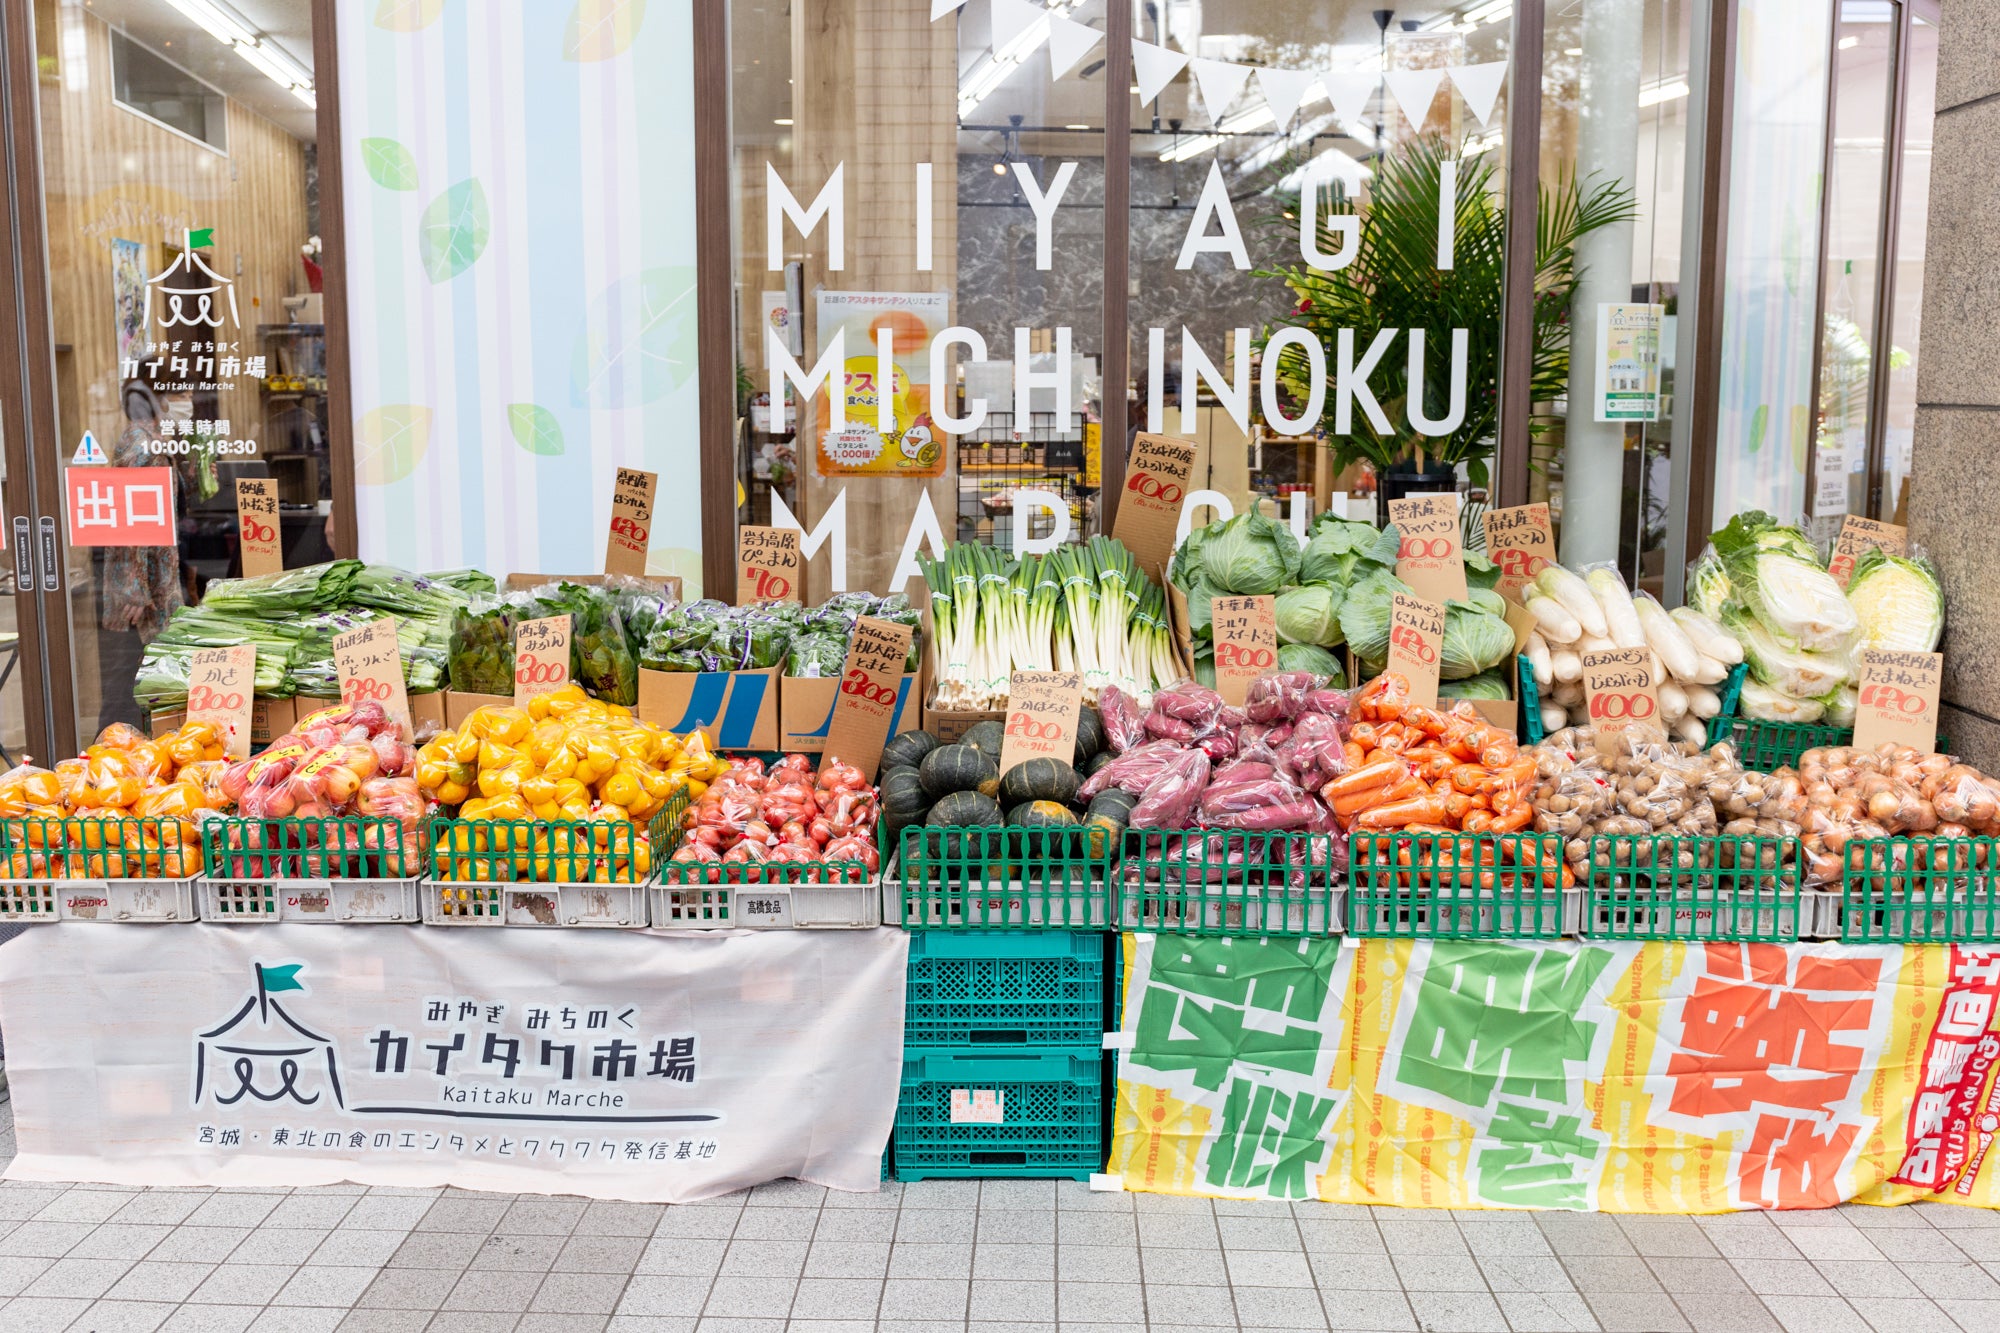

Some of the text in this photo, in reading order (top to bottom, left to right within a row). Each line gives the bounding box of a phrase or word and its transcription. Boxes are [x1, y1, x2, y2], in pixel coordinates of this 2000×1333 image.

[766, 158, 1456, 271] MIYAGI
[146, 340, 240, 353] みやぎ みちのく
[121, 355, 267, 379] カイタク市場
[153, 381, 235, 391] Kaitaku Marche
[768, 324, 1470, 436] MICHINOKU
[159, 419, 230, 436] 営業時間
[76, 480, 166, 528] 出口
[240, 497, 277, 514] 小松菜
[242, 514, 276, 543] 50
[1487, 510, 1533, 532] 青森産
[742, 530, 795, 550] 岩手高原
[1491, 527, 1546, 549] だいこん
[746, 567, 790, 599] 70
[1214, 597, 1257, 612] 千葉産
[1217, 617, 1248, 629] シルク
[335, 627, 374, 651] 山形産
[525, 630, 565, 652] みかん
[1225, 629, 1261, 642] スイート
[856, 657, 893, 675] とまと
[1216, 642, 1274, 668] 200
[201, 667, 239, 687] かき
[516, 653, 566, 685] 300
[1864, 667, 1937, 689] たまねぎ
[188, 685, 245, 712] 300
[841, 669, 897, 706] 300
[1860, 685, 1927, 714] 120
[1590, 693, 1655, 719] 100
[1006, 712, 1062, 740] 200
[747, 899, 782, 914] 高橋食品
[427, 1000, 637, 1031] みやぎ みちのく
[369, 1029, 696, 1084] カイタク市場
[443, 1085, 625, 1109] Kaitaku Marche
